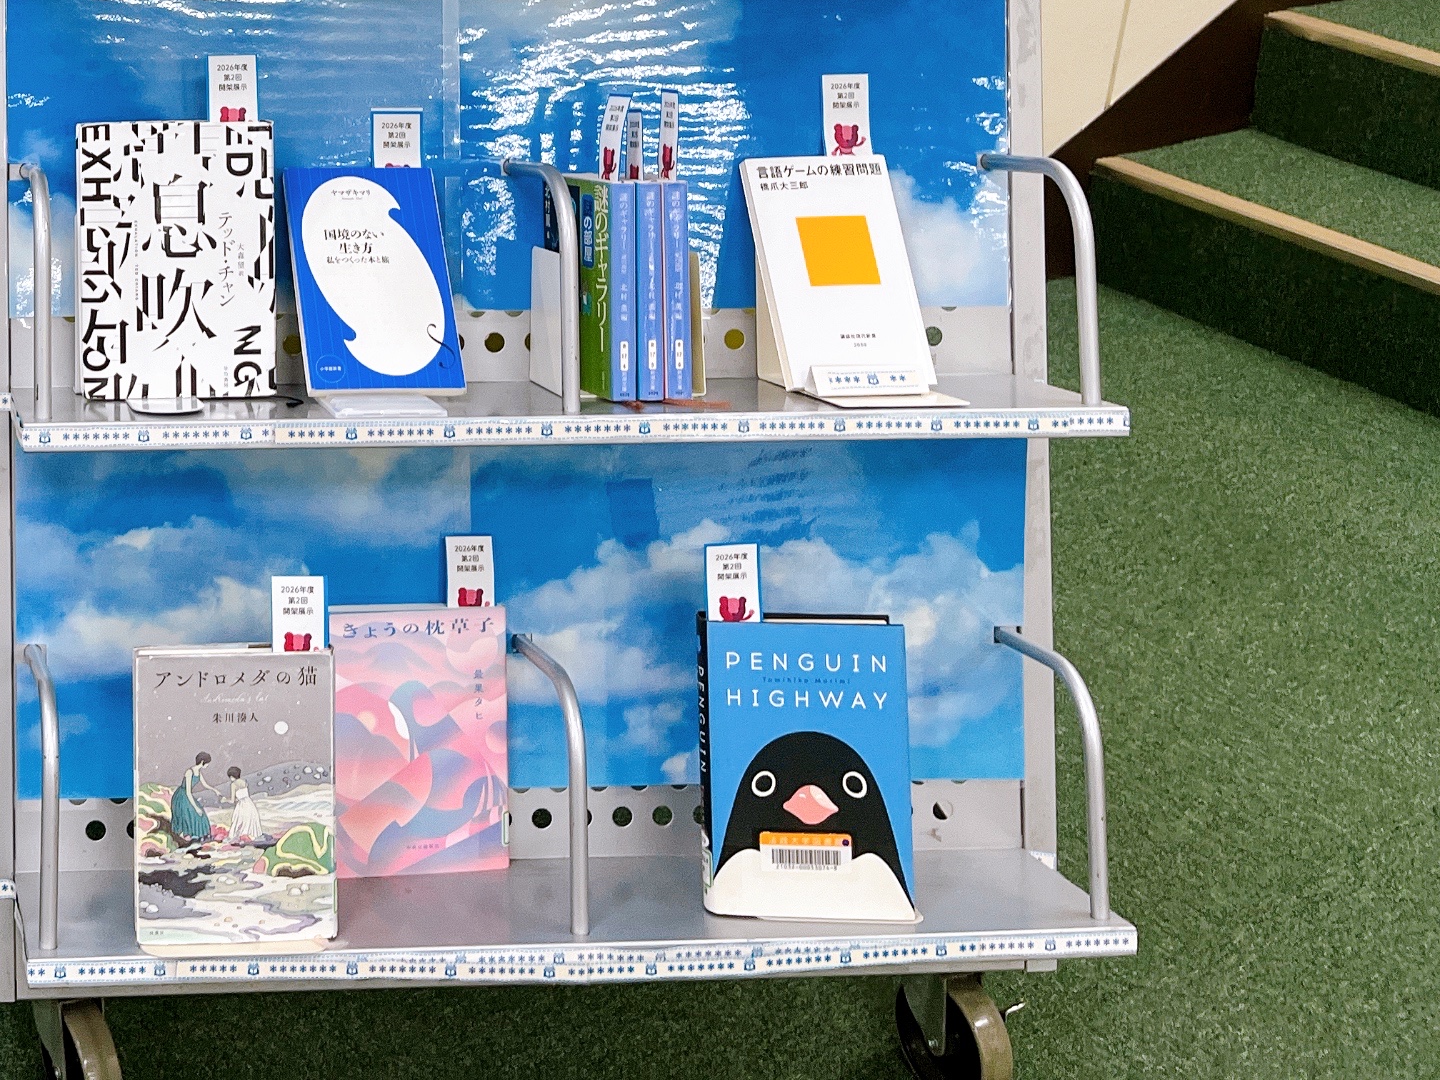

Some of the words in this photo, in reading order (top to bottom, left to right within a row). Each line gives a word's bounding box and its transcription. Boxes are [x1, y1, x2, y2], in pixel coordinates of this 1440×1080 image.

[216, 63, 249, 72] 2026年度
[223, 73, 243, 82] 第2回
[218, 82, 247, 92] 開架展示
[381, 122, 412, 130] 2026年度
[388, 131, 406, 139] 第2回
[756, 163, 882, 180] 言語ゲームの練習問題
[323, 228, 385, 241] 国境のない
[339, 242, 374, 254] 生き方
[218, 211, 236, 307] テッド・チャン
[326, 256, 390, 265] 私をつくった本と旅
[455, 544, 485, 554] 2026年度
[461, 554, 479, 563] 第2回
[715, 552, 748, 561] 2026年度
[456, 564, 485, 573] 開架展示
[723, 562, 742, 570] 第2回
[280, 585, 315, 595] 2026年度
[288, 596, 308, 605] 第2回
[283, 607, 314, 616] 開架展示
[342, 617, 495, 639] きょうの枕草子
[726, 651, 887, 673] PENGUIN
[154, 665, 318, 688] アンドロメダの猫
[473, 668, 485, 721] 最果タヒ
[727, 688, 888, 709] HIGHWAY
[697, 665, 708, 773] PENGUIN
